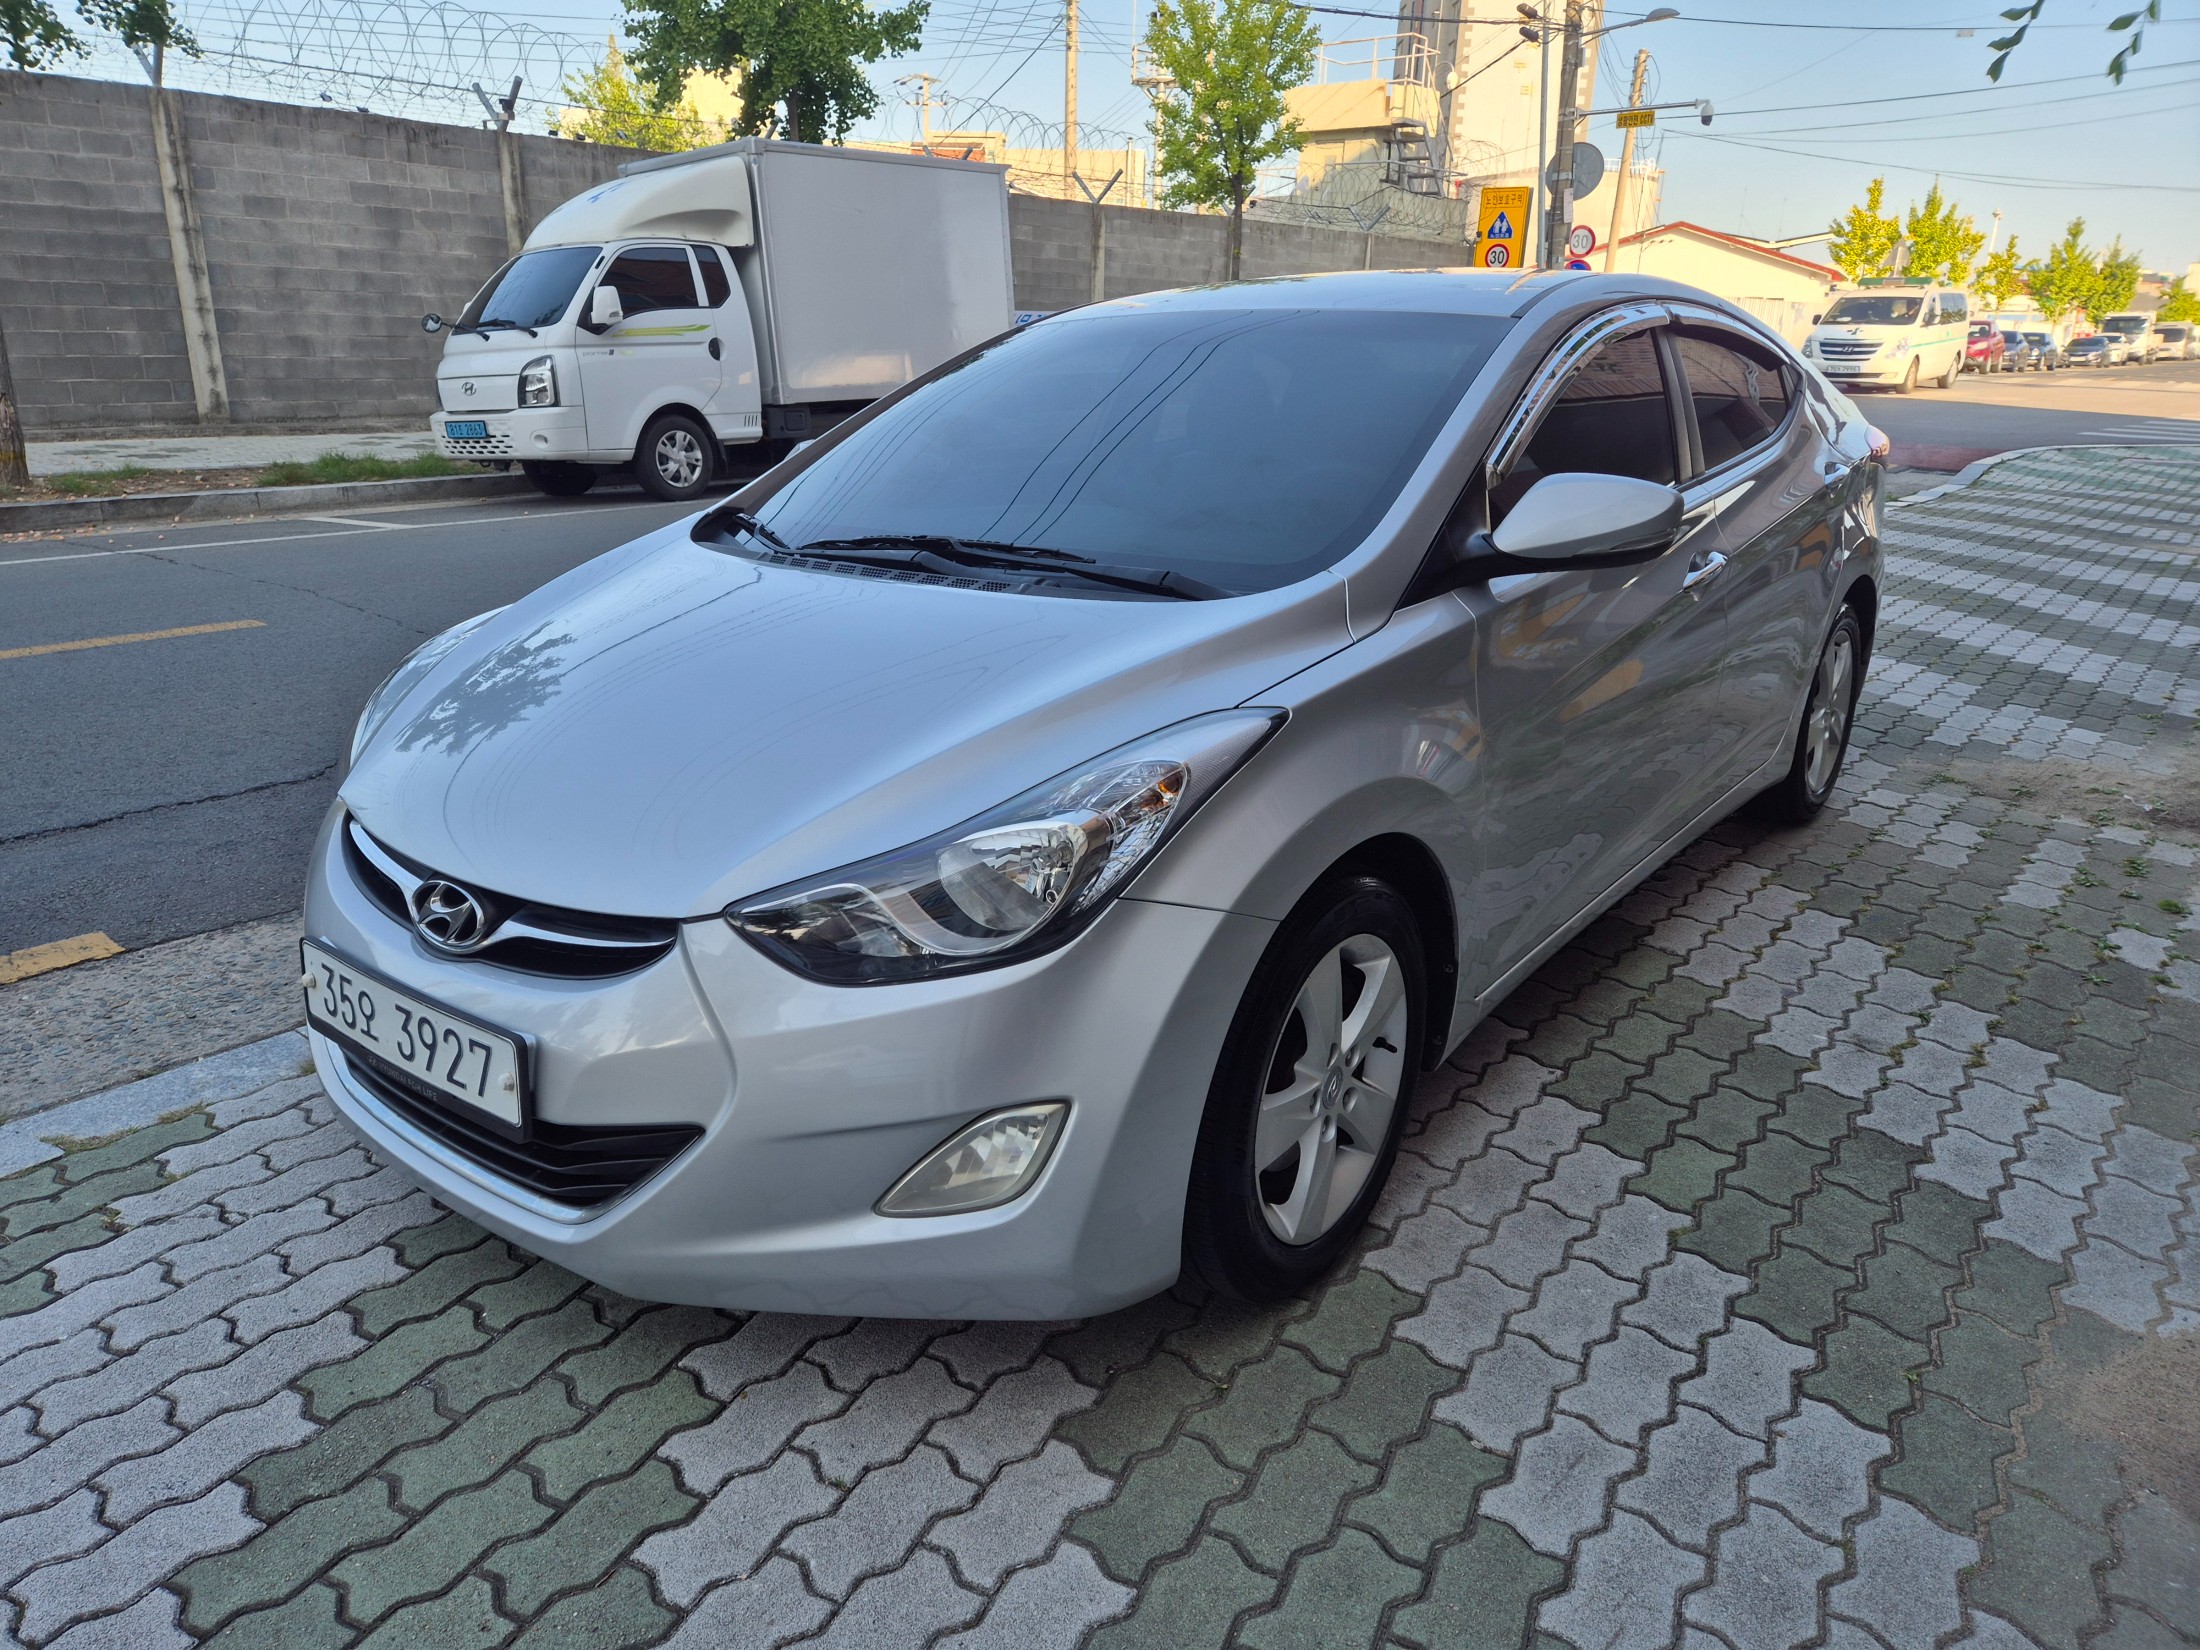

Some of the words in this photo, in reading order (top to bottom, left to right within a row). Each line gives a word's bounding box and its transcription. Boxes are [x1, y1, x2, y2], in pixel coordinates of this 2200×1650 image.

[1640, 113, 1653, 125] CCTV
[1485, 193, 1523, 206] 노인보호구역
[1573, 234, 1589, 249] 30
[1489, 250, 1505, 265] 30
[464, 423, 483, 436] 2863
[321, 963, 379, 1043] 35오
[395, 1003, 492, 1098] 3927
[422, 1086, 438, 1102] LIFE
